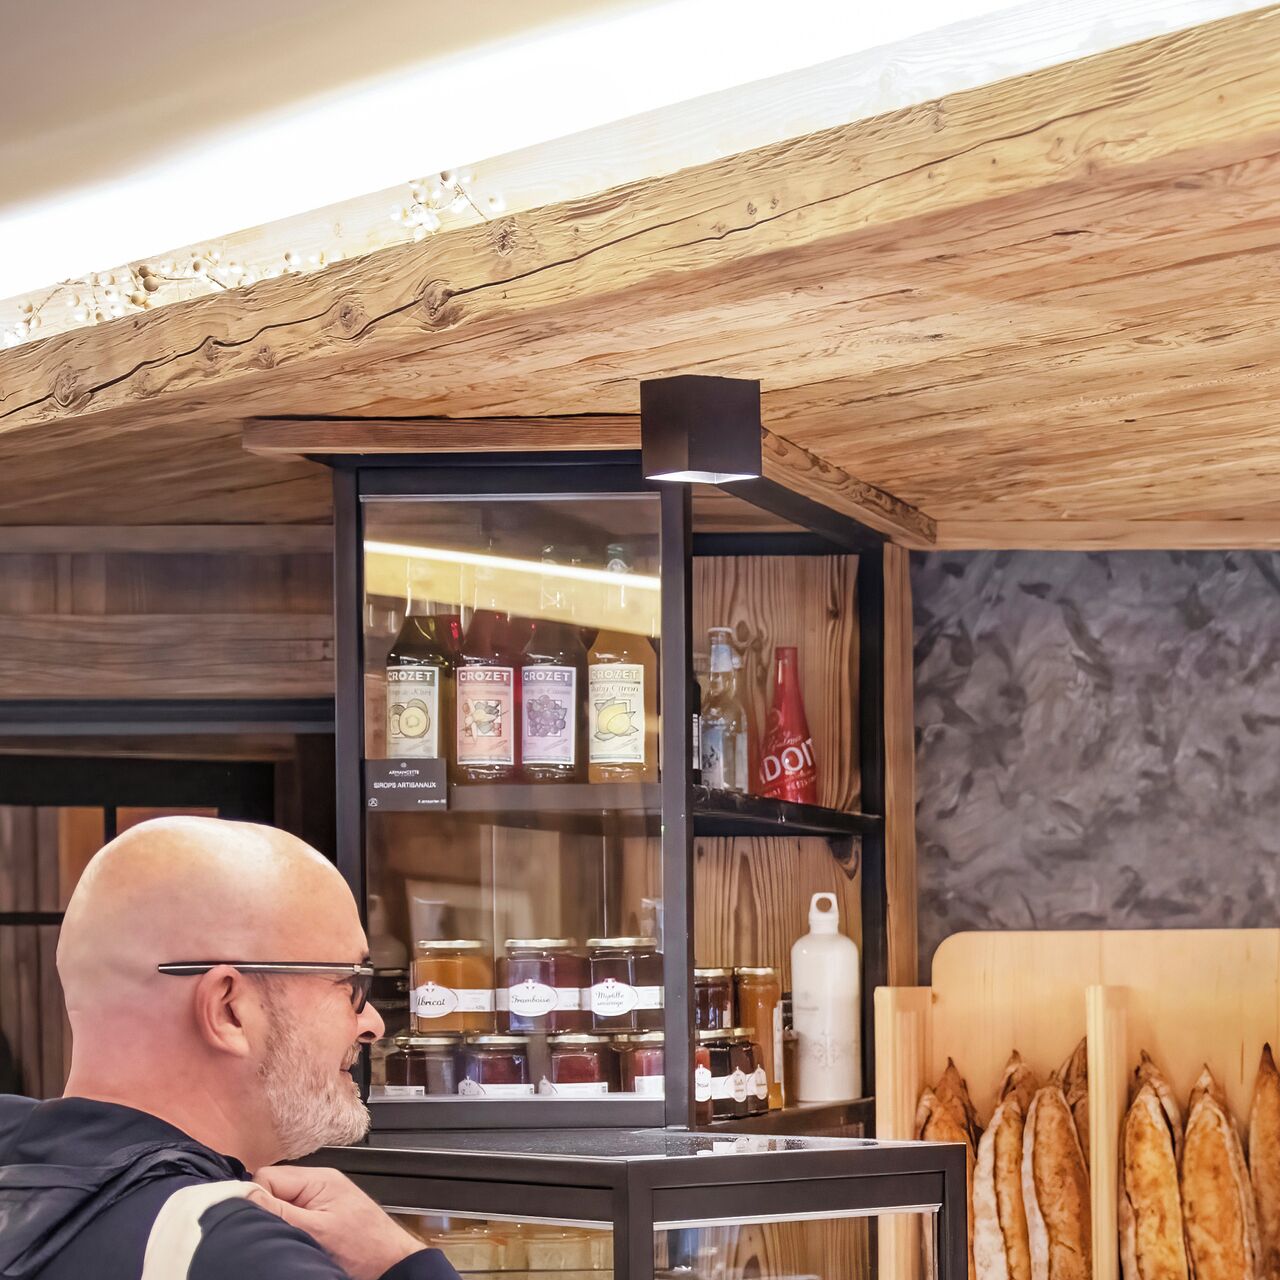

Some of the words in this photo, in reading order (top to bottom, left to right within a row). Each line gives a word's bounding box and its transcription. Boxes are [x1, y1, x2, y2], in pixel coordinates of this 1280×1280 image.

[388, 671, 433, 681] CROZET
[460, 672, 509, 681] CROZET
[523, 672, 570, 681] CROZET
[591, 670, 638, 680] CROZET
